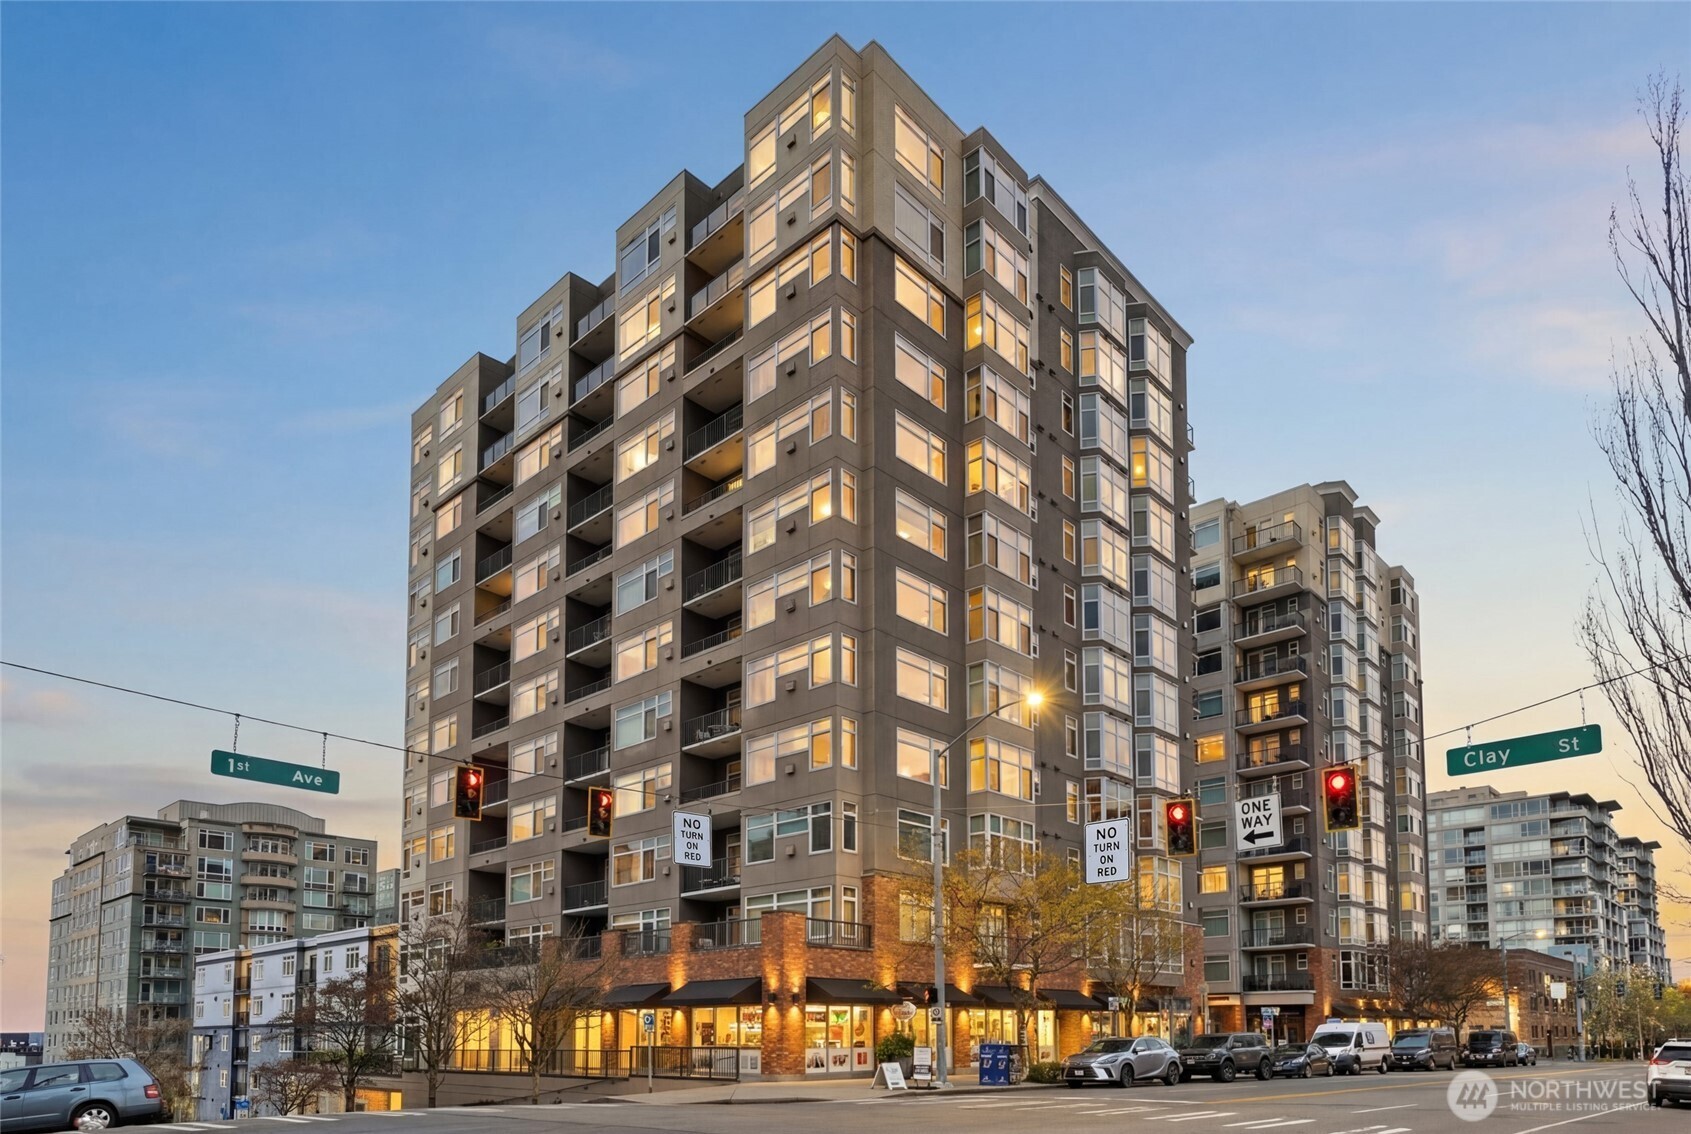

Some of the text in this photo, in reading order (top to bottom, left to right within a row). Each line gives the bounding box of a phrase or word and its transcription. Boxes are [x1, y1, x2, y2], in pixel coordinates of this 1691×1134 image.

[1464, 736, 1580, 767] Clay St
[227, 758, 323, 786] 1st Ave
[1241, 798, 1271, 815] ONE
[683, 817, 701, 830] NO
[1241, 813, 1272, 829] WAY
[680, 829, 704, 841] TURN
[1096, 826, 1117, 841] NO
[686, 841, 698, 850] ON
[1093, 840, 1120, 853] TURN
[684, 851, 702, 861] RED
[1100, 854, 1114, 865] ON
[1097, 866, 1117, 877] RED
